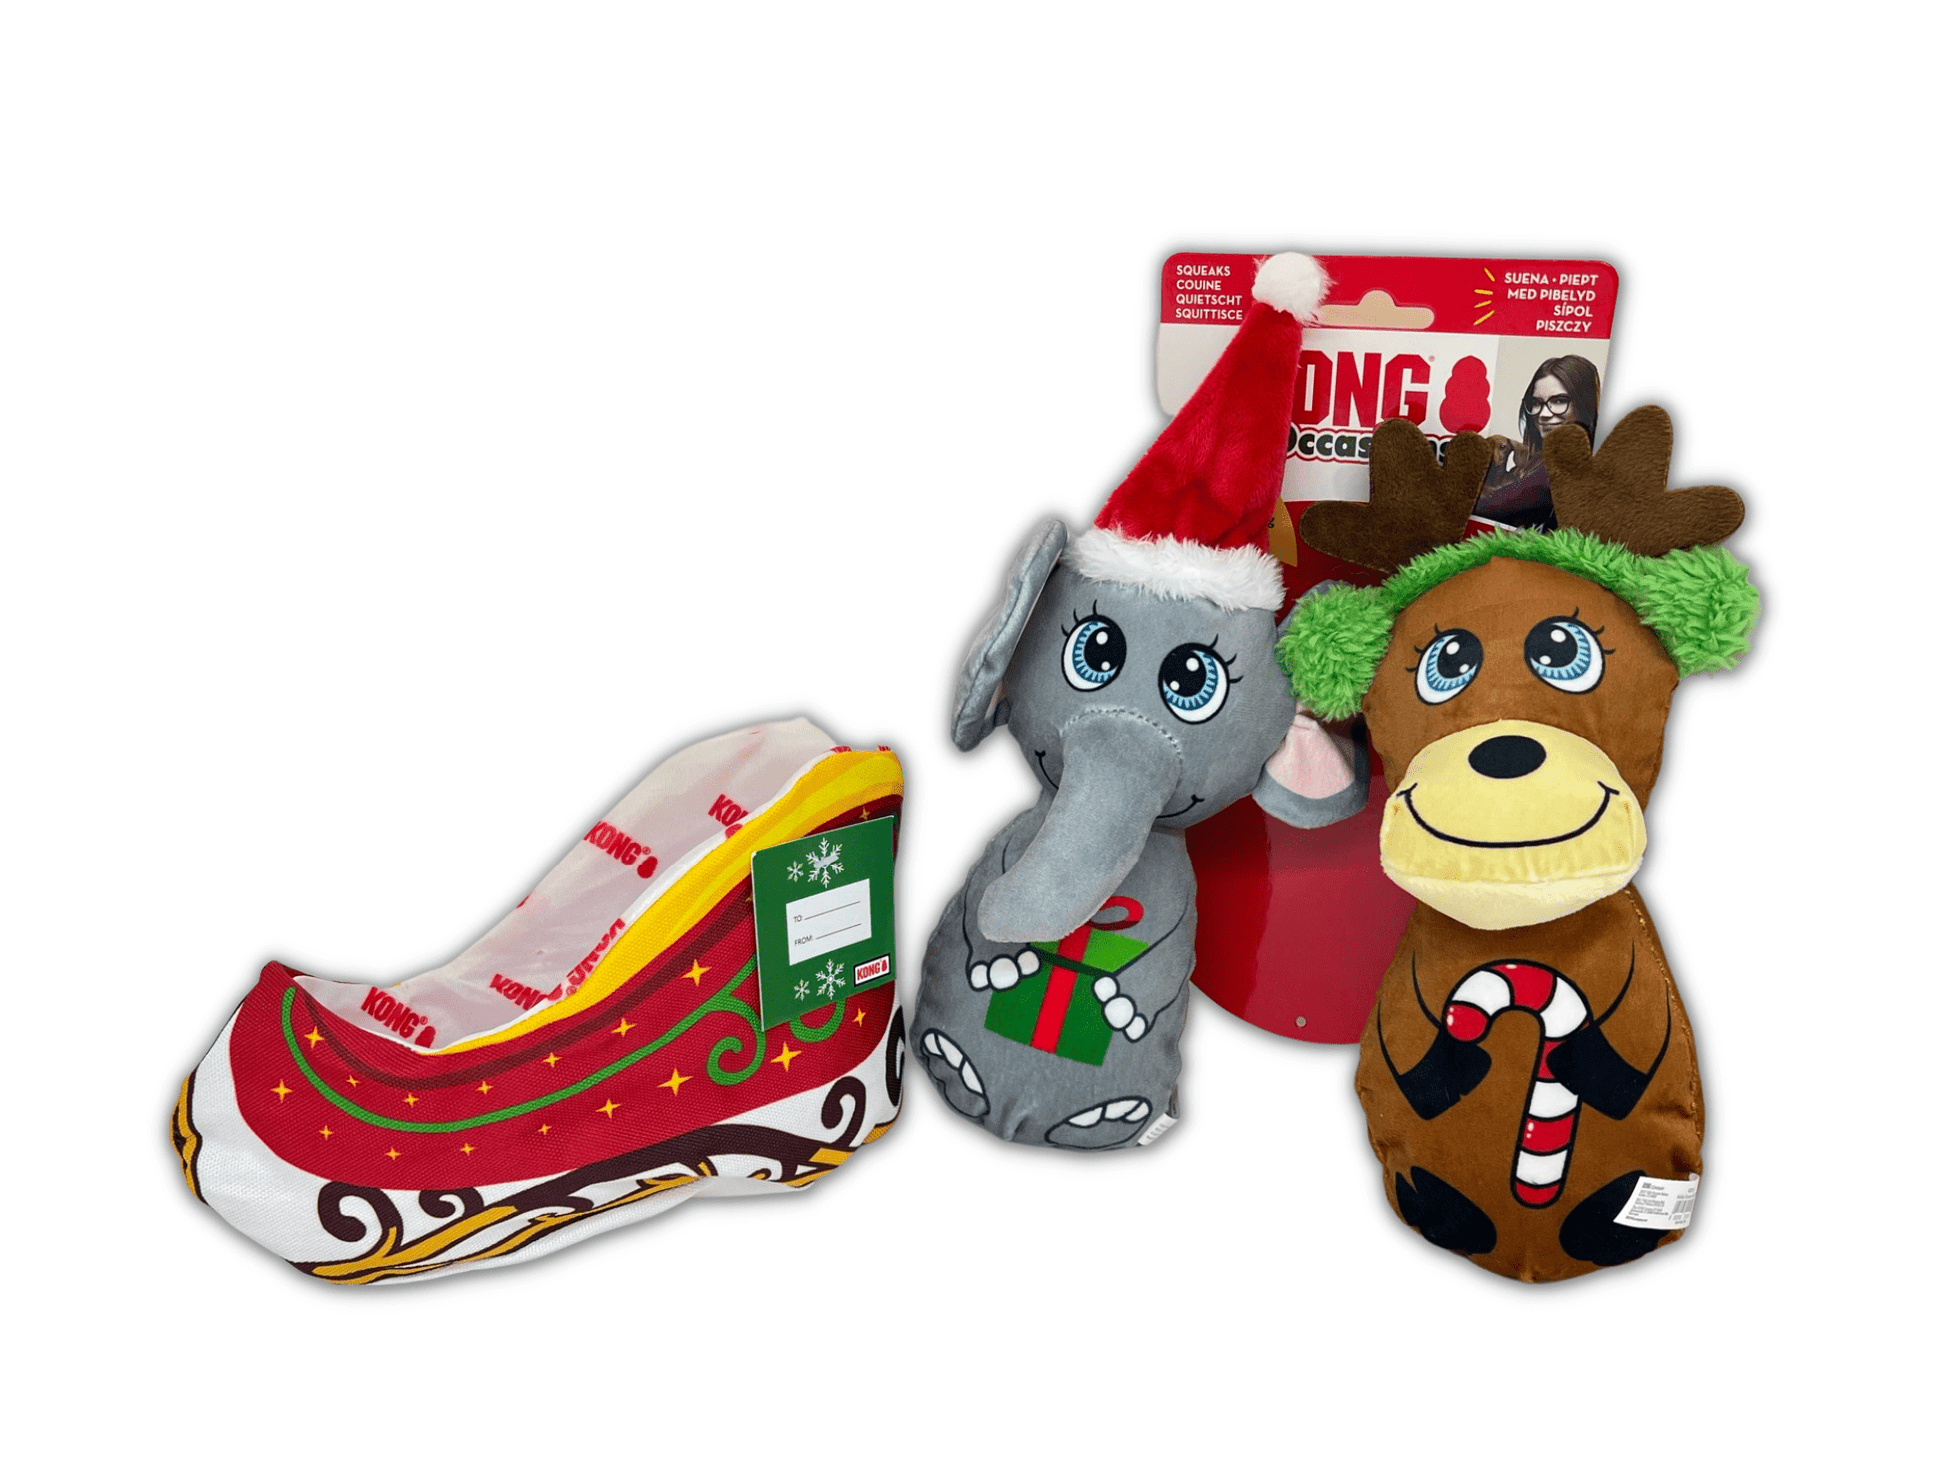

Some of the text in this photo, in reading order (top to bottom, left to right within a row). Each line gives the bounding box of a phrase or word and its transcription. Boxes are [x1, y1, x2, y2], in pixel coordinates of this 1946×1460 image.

[1176, 264, 1231, 277] SQUEAKS
[1176, 279, 1222, 291] COUINE
[1504, 272, 1599, 286] SUENA PIEPT
[1175, 293, 1243, 306] QUIETSCHT
[1507, 288, 1597, 302] MED PIBELYD
[1175, 308, 1243, 320] SQUITTISCE
[1553, 301, 1594, 318] SÍPOL
[1536, 319, 1592, 333] PISZCZY
[1291, 349, 1432, 428] ONG
[856, 961, 881, 981] KONG
[360, 986, 421, 1039] KONG
